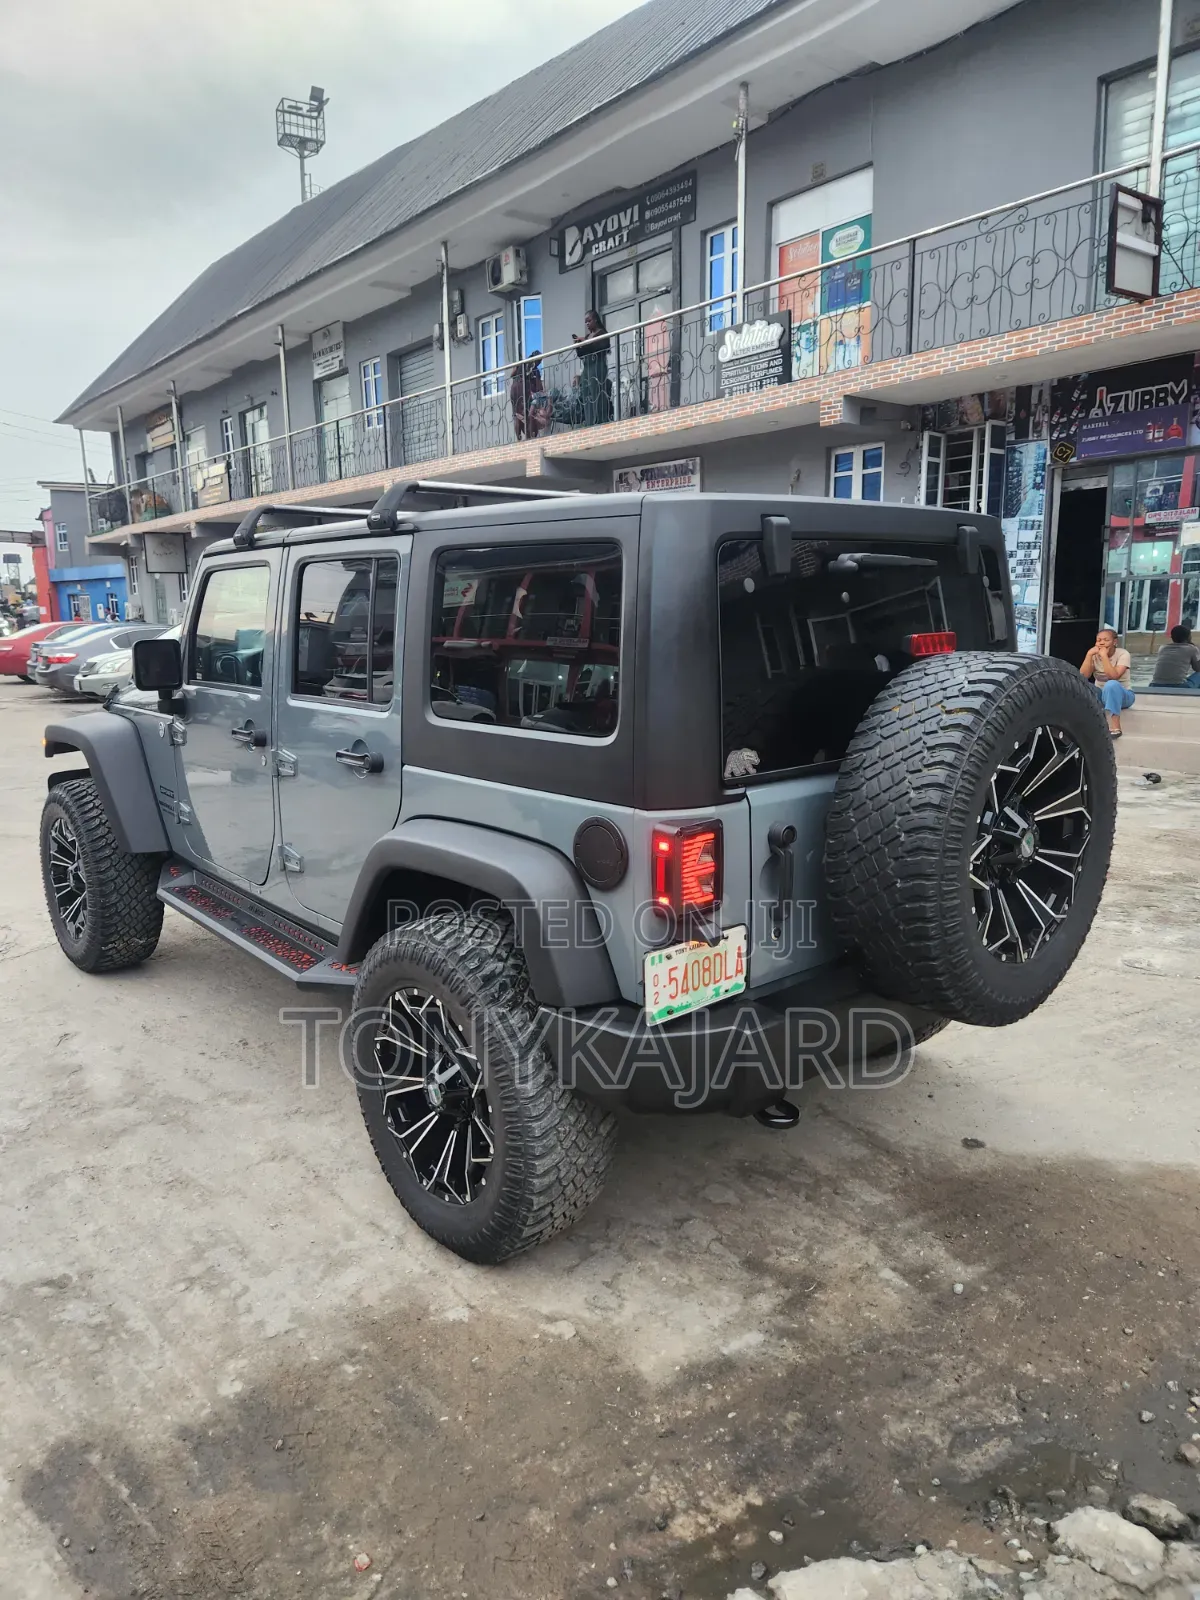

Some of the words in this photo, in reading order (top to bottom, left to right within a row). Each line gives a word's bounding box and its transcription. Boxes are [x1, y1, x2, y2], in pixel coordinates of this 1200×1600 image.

[565, 204, 640, 266] BAYOVI
[592, 231, 630, 256] CRAFT
[719, 320, 783, 362] Solution
[732, 348, 751, 358] ALTER
[752, 341, 775, 352] EMPIRE
[751, 361, 769, 371] ITEMS
[769, 358, 783, 367] AND
[721, 374, 750, 386] DESIGNER
[750, 366, 783, 379] PERFUMES
[1099, 431, 1132, 440] RESOURCES
[1055, 446, 1072, 456] C7
[646, 475, 692, 489] ENTERPRISE
[668, 945, 744, 1000] 5408DLA
